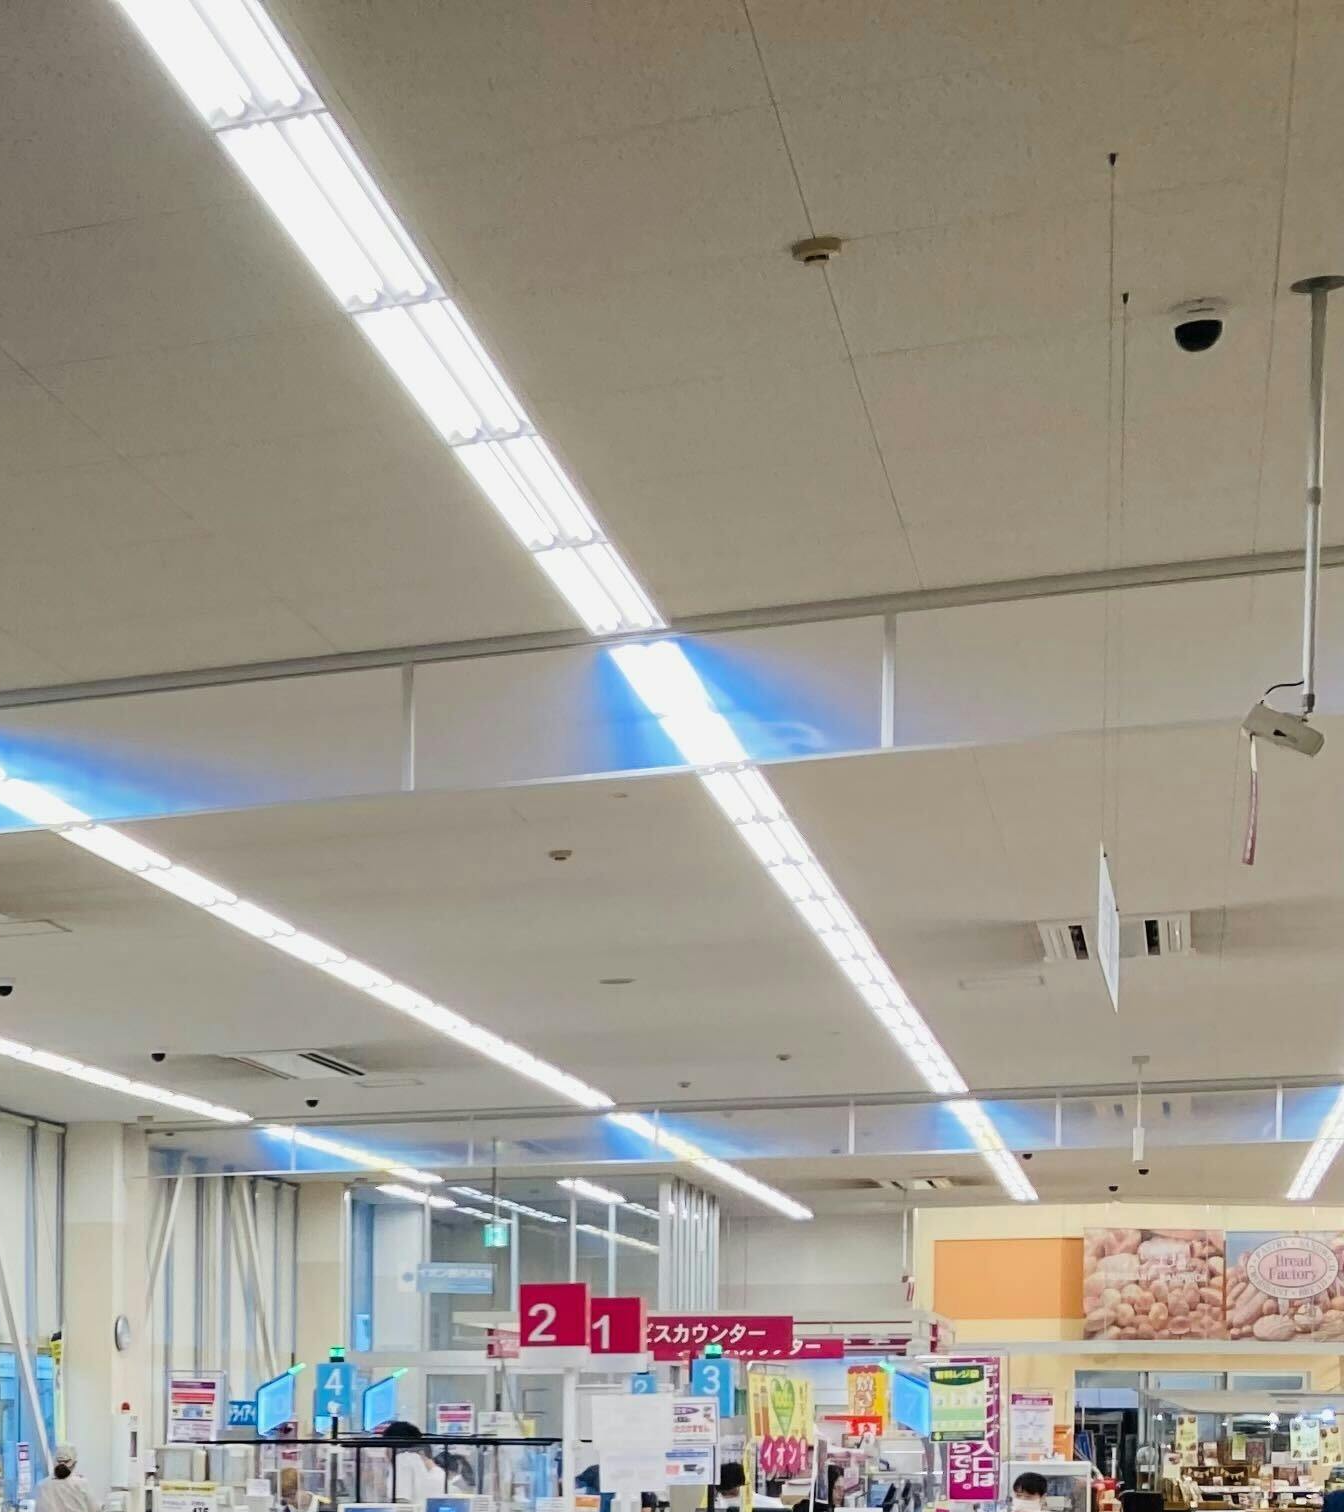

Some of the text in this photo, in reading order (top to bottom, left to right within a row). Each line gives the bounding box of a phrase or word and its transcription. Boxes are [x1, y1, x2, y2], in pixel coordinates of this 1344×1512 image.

[528, 1303, 557, 1342] 2
[591, 1314, 610, 1350] 1
[324, 1368, 343, 1394] 4
[702, 1365, 720, 1395] 3
